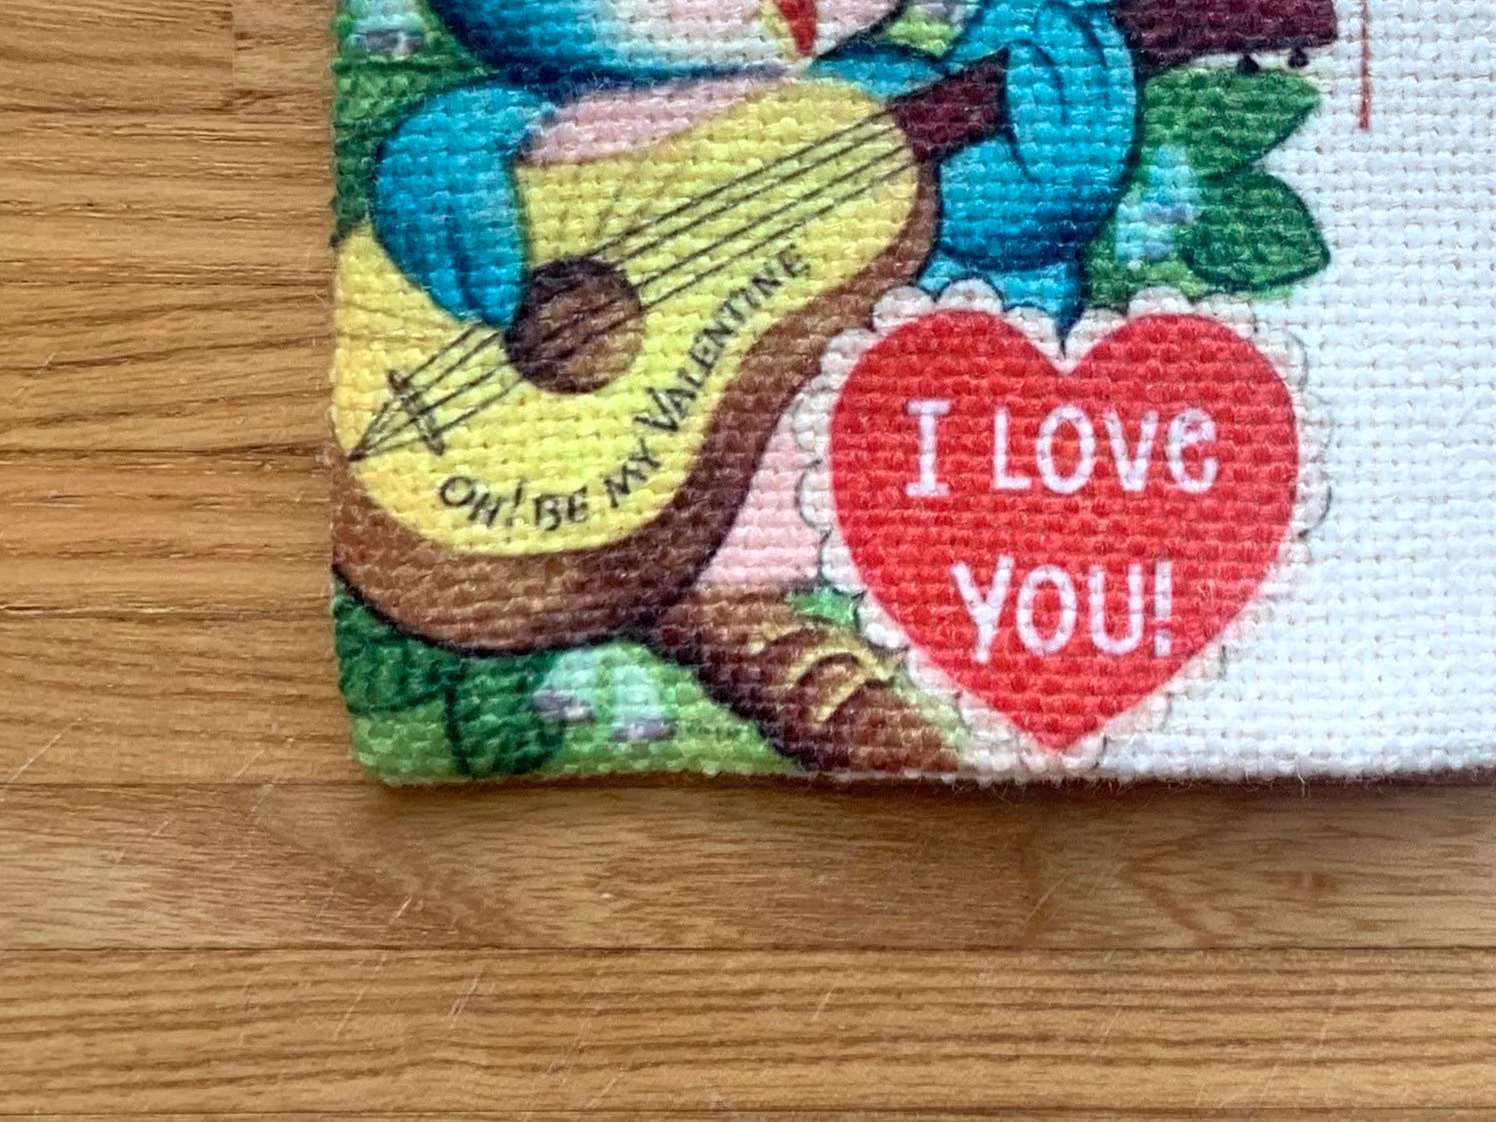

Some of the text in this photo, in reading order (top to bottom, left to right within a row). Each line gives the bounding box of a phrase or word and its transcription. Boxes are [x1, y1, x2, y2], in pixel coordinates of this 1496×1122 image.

[632, 242, 812, 435] VALENTINE
[603, 438, 662, 510] MY
[904, 397, 953, 498] I
[534, 484, 590, 532] BE
[951, 554, 1174, 665] YOU!
